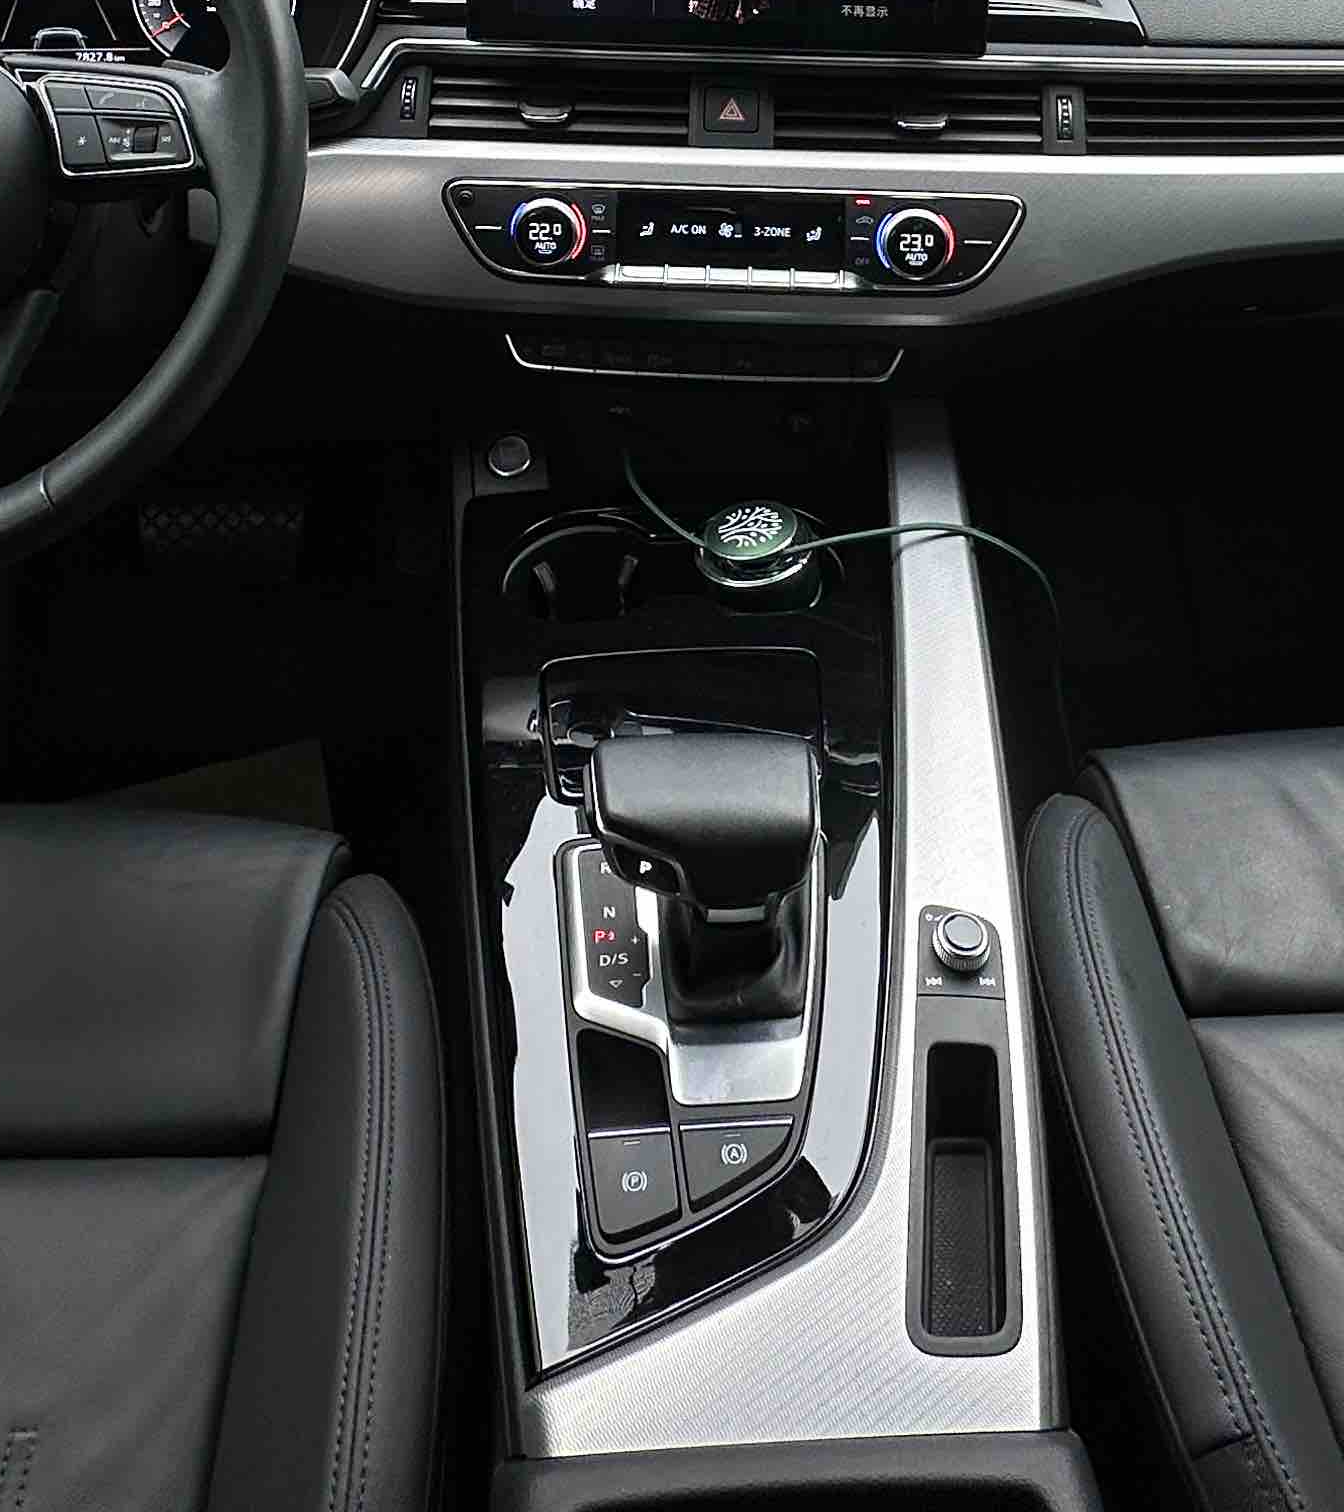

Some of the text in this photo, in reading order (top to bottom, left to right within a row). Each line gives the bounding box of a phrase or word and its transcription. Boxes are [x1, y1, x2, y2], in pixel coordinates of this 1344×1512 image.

[840, 4, 889, 18] 不再显示
[670, 223, 706, 235] A/C ON
[754, 226, 792, 238] 3-ZONE
[534, 241, 557, 250] AUTO
[905, 253, 928, 262] AUTO
[600, 861, 612, 874] R
[639, 860, 653, 874] P
[603, 906, 616, 919] N
[599, 952, 629, 967] D/S
